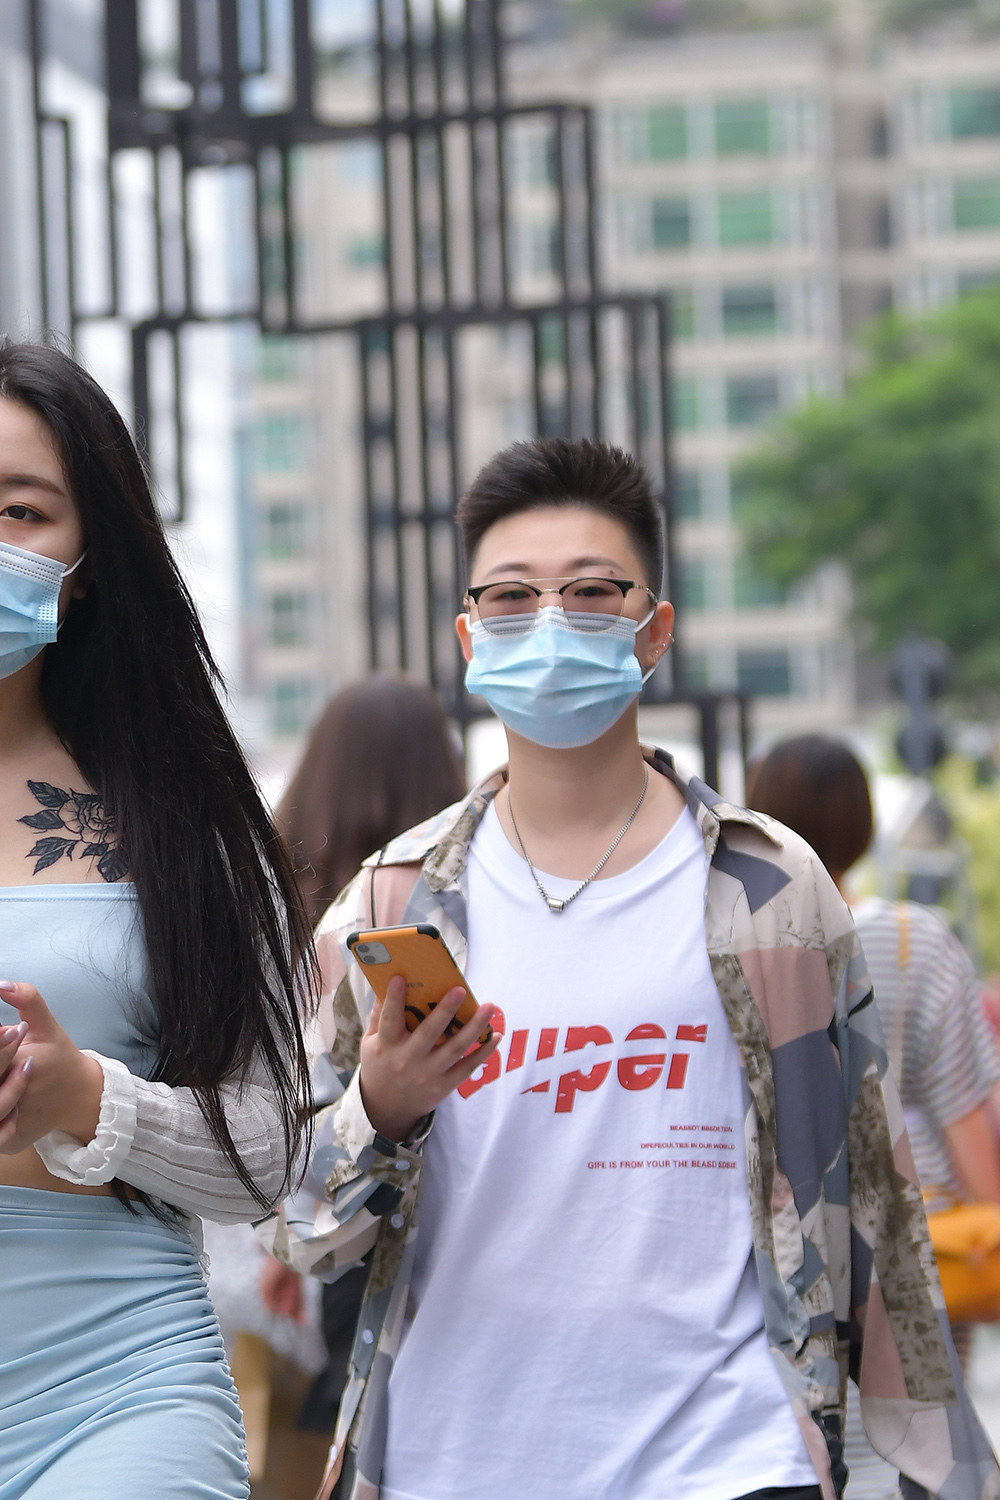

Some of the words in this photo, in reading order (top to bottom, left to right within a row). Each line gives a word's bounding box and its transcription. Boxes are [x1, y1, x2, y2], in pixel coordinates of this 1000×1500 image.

[609, 1161, 617, 1169] IS
[619, 1160, 644, 1169] FROM
[646, 1160, 670, 1168] YOUR
[672, 1160, 688, 1168] THE
